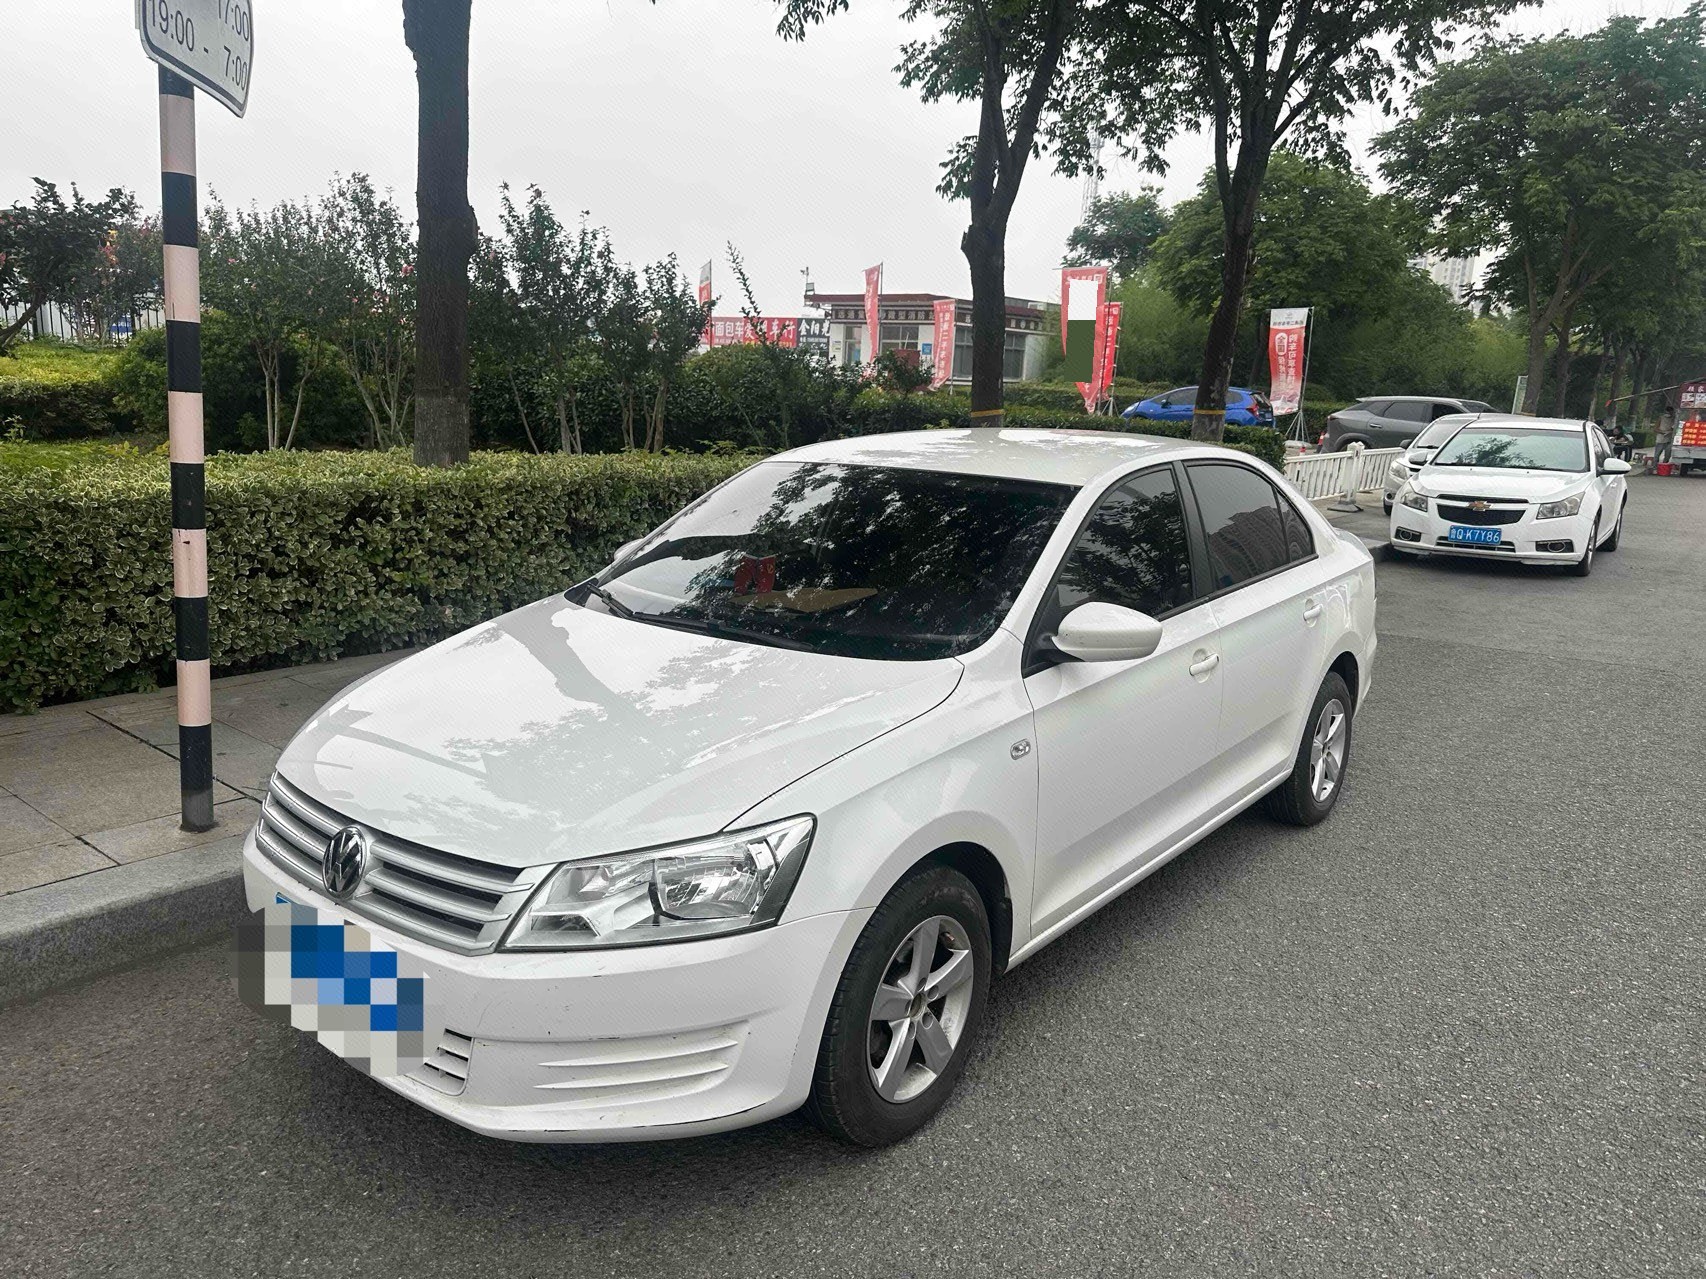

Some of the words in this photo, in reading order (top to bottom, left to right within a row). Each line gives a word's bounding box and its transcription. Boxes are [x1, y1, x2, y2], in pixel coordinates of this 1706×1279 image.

[152, 0, 195, 51] 19:00
[224, 45, 247, 91] 7:00
[712, 321, 744, 337] 面包车
